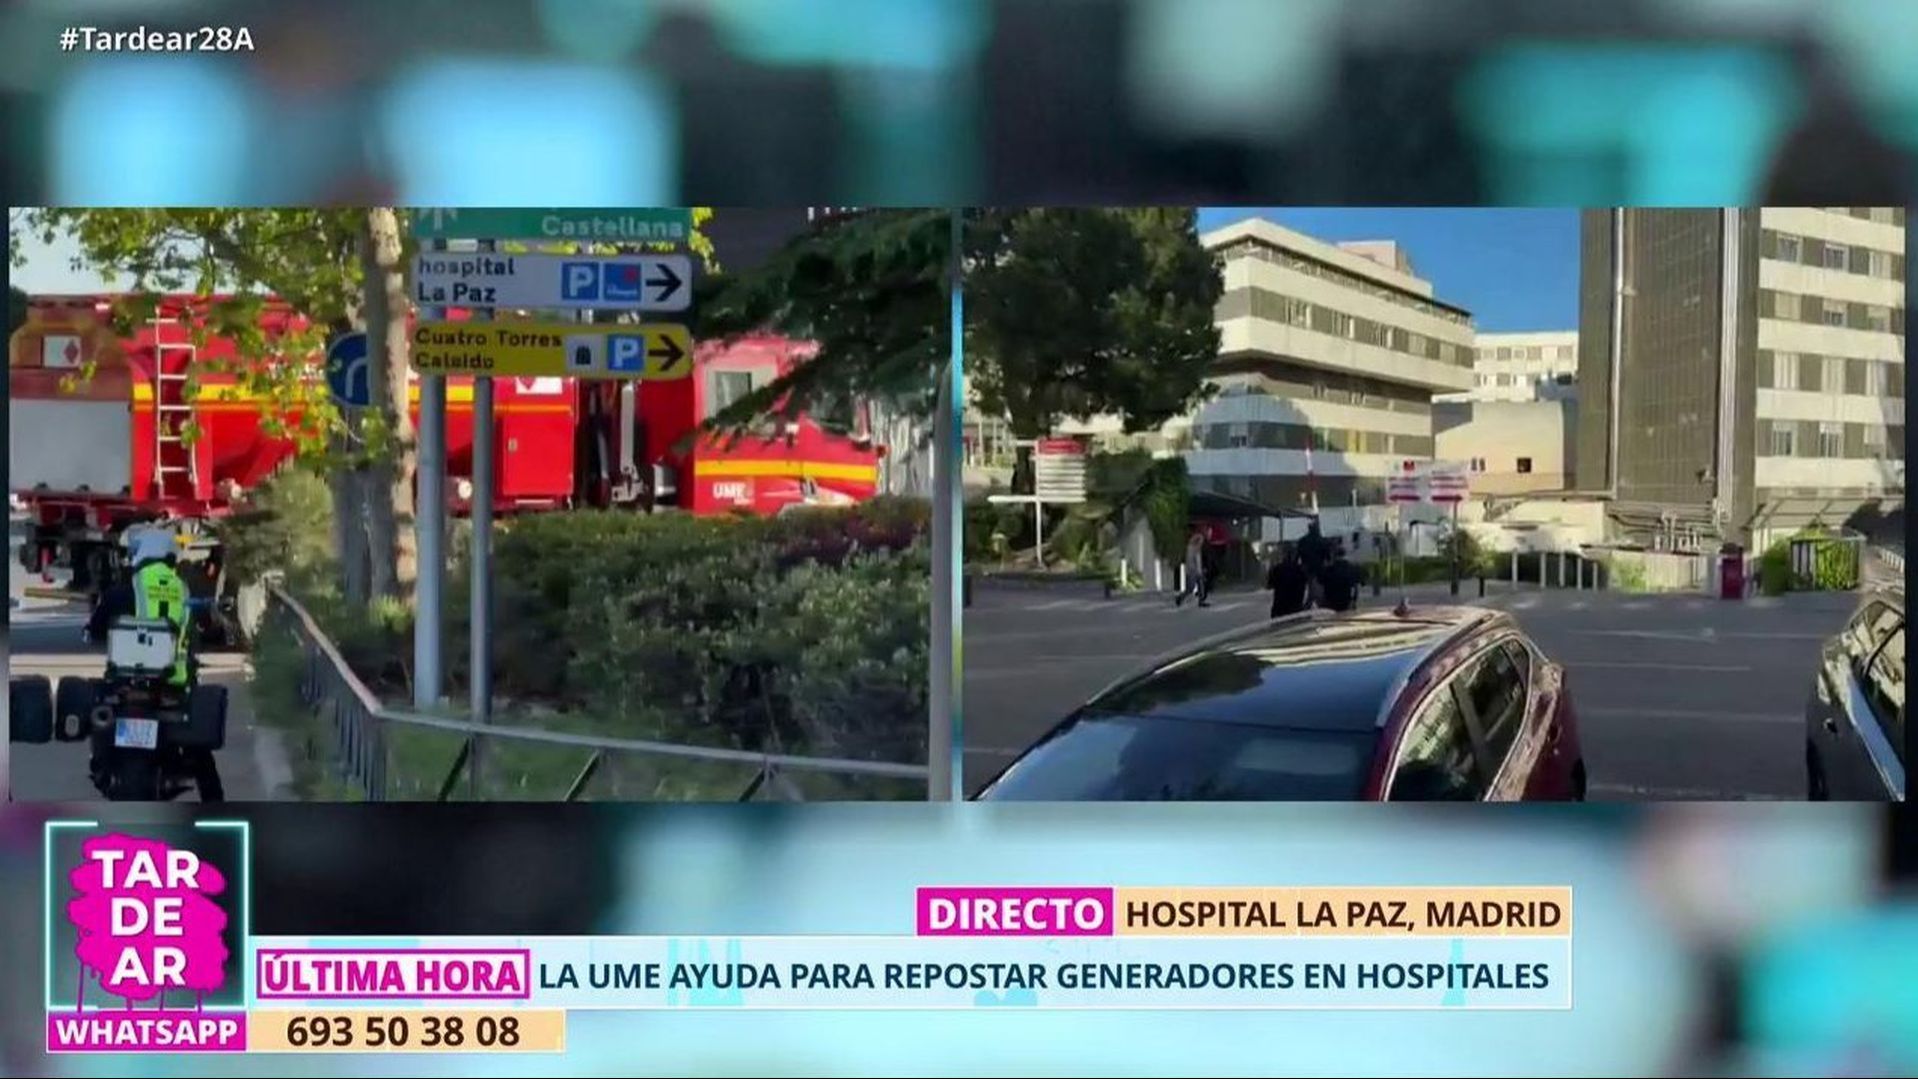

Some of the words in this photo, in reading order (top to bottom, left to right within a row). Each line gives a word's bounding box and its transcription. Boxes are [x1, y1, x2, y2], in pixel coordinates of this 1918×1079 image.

[542, 216, 683, 237] Castellana
[419, 257, 515, 277] hospital
[569, 266, 594, 297] P
[418, 282, 445, 302] La
[453, 282, 496, 302] Paz
[415, 328, 487, 345] Cuatro
[496, 330, 562, 347] Torres
[614, 338, 644, 368] P
[713, 481, 746, 499] UME
